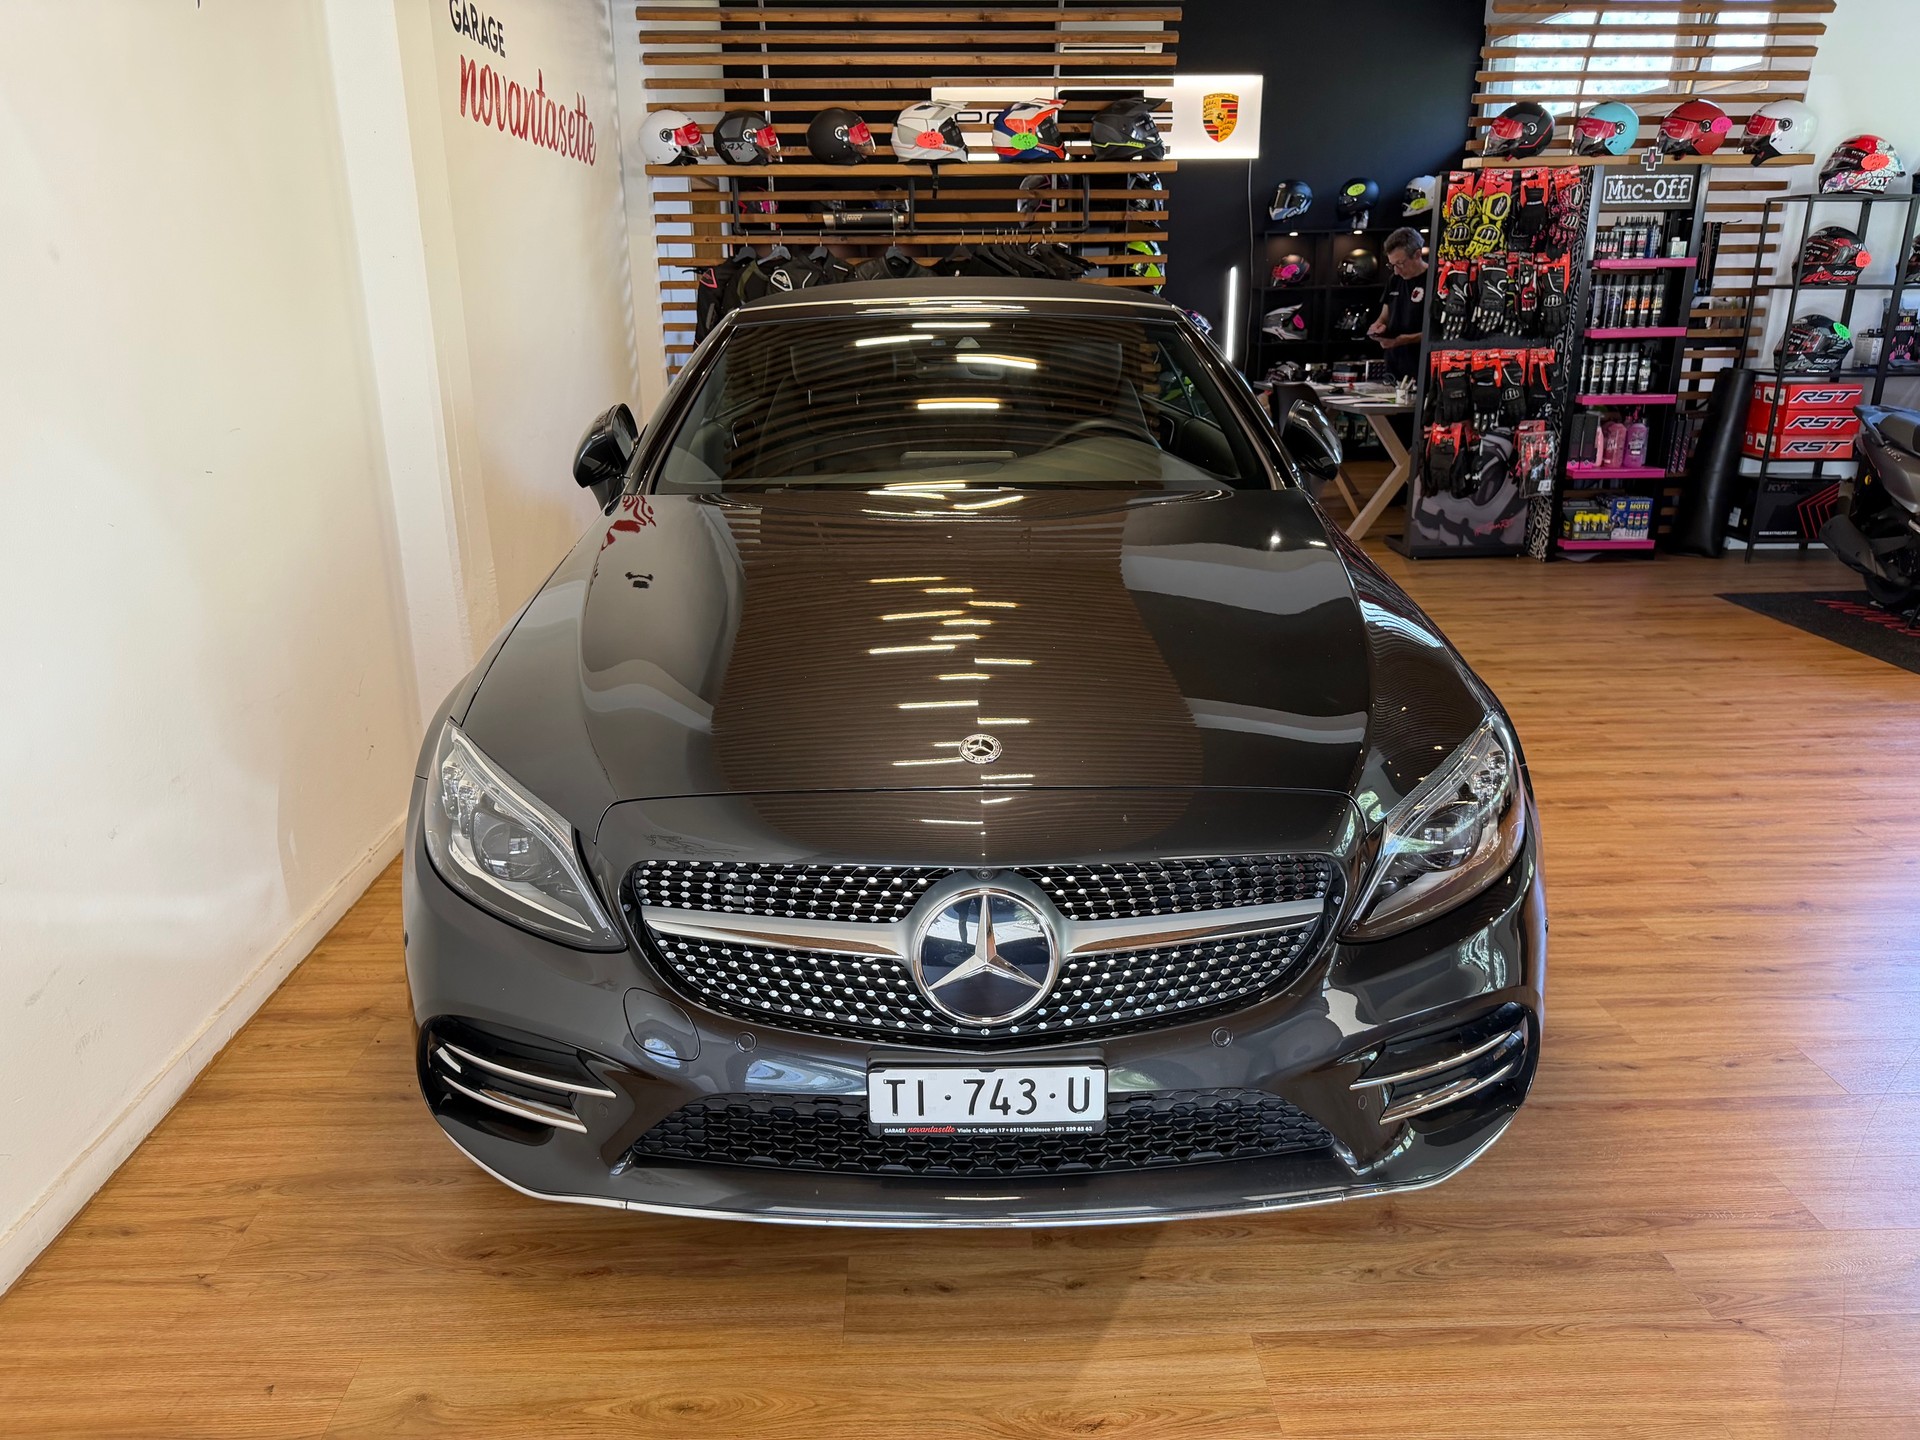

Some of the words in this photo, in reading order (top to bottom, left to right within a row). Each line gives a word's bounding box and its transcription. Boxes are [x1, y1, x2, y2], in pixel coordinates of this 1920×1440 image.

[450, 0, 506, 58] GARAGE
[460, 54, 597, 166] novantasette
[1606, 178, 1689, 200] Muc-Off
[1788, 389, 1862, 403] RST
[1784, 415, 1859, 429] RST
[1780, 440, 1854, 454] RST
[883, 1079, 925, 1117] TI
[963, 1078, 1037, 1116] 743
[1067, 1077, 1090, 1115] U
[907, 1125, 956, 1134] novantasette
